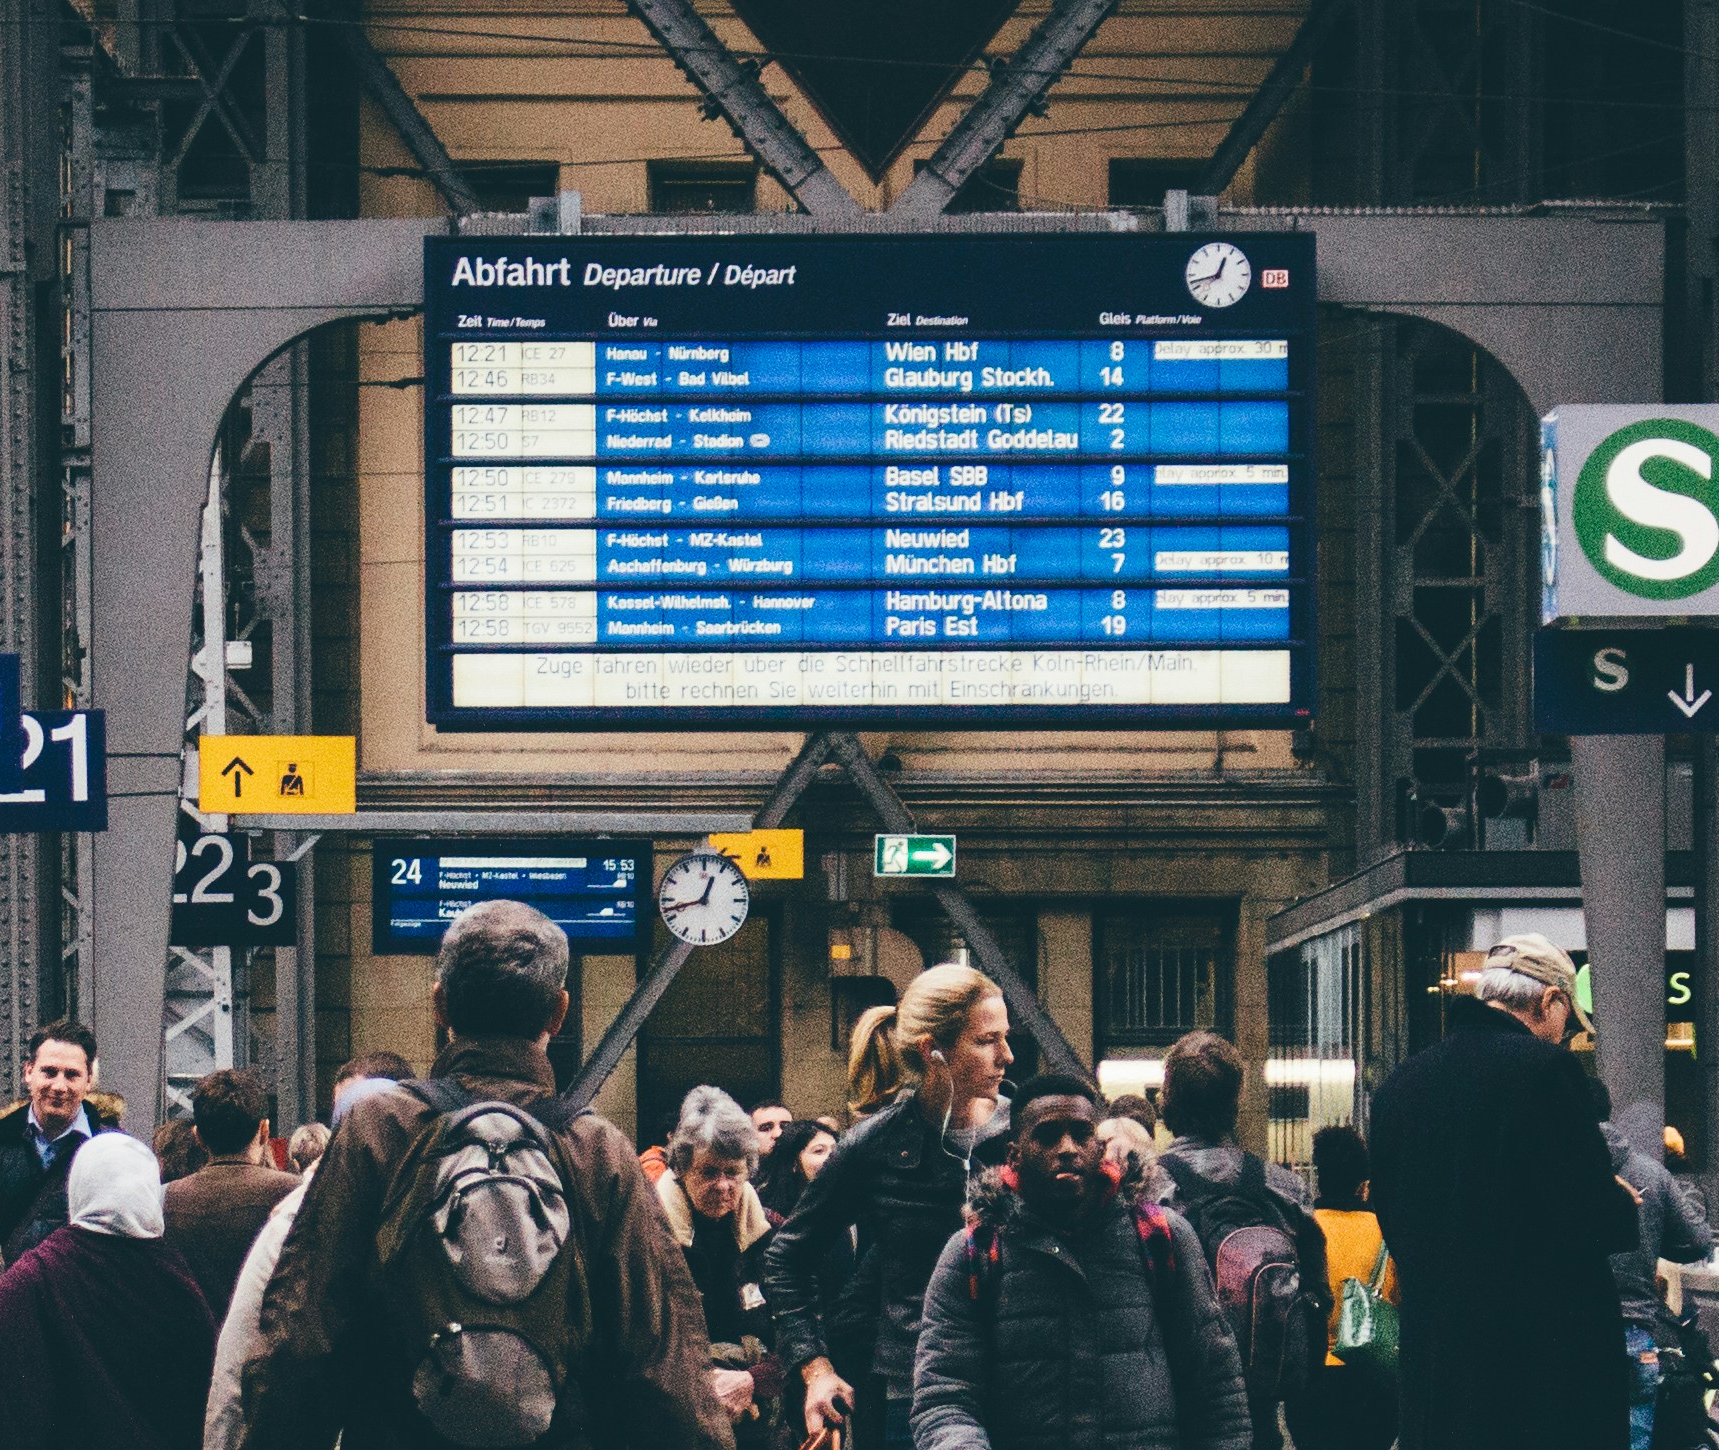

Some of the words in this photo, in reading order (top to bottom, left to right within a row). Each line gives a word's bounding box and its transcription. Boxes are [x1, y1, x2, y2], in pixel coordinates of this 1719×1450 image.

[451, 257, 571, 286] Abfahrt
[583, 264, 701, 290] Departure
[707, 262, 720, 285] /
[724, 264, 797, 289] Départ
[1265, 271, 1287, 286] DB
[458, 315, 482, 327] Zeit
[608, 312, 639, 327] Über
[643, 317, 658, 327] Via
[887, 312, 911, 326] Ziel
[915, 315, 968, 326] Destination
[1099, 312, 1131, 325] Gleis
[457, 345, 506, 362] 12:21
[605, 346, 648, 361] Hanau
[668, 346, 730, 364] Nürnberg
[885, 341, 937, 362] Wien
[944, 341, 979, 362] Hbf
[1109, 340, 1125, 362] 8
[457, 370, 508, 387] 12:46
[605, 371, 658, 387] F-West
[678, 371, 706, 387] Bad
[711, 371, 750, 387] Vilbel
[885, 367, 973, 392] Glauburg
[981, 366, 1055, 388] Stockh.
[1099, 366, 1124, 387] 14
[457, 407, 508, 424] 12:47
[606, 408, 668, 424] F-Höchst
[688, 408, 752, 423] Kelkheim
[885, 403, 987, 429] Königstein
[994, 403, 1033, 425] (Ts)
[1098, 403, 1125, 424] 22
[457, 433, 508, 450] 12:50
[606, 434, 673, 449] Niederrad
[693, 433, 744, 449] Stadion
[885, 429, 979, 450] Riedstadt
[987, 429, 1079, 450] Goddelau
[1109, 428, 1125, 450] 2
[457, 469, 508, 487] 12:50
[606, 471, 674, 486] Mannheim
[694, 470, 761, 485] Karlsruhe
[885, 466, 940, 487] Basel
[949, 466, 988, 487] SBB
[1110, 465, 1126, 486] 9
[457, 495, 507, 512] 12:51
[606, 496, 672, 514] Friedberg
[693, 496, 739, 511] Gießen
[885, 491, 982, 512] Stralsund
[989, 490, 1024, 512] Hbf
[1100, 490, 1126, 512] 16
[1605, 438, 1719, 581] S
[458, 532, 508, 549] 12:53
[606, 533, 669, 548] F-Höchst
[688, 533, 763, 548] MZ-Kastel
[885, 528, 970, 549] Neuwied
[1098, 528, 1126, 549] 23
[458, 557, 508, 575] 12:54
[607, 558, 707, 576] Aschaffenburg
[728, 558, 793, 575] Würzburg
[885, 554, 974, 574] München
[983, 553, 1017, 574] Hbf
[1111, 553, 1126, 574] 7
[459, 594, 509, 611] 12:58
[607, 595, 732, 610] Kassel-Wilhelmsh.
[753, 595, 816, 609] Hannover
[885, 590, 1048, 615] Hamburg-Altona
[1112, 589, 1126, 610] 8
[459, 620, 509, 637] 12:58
[607, 621, 675, 636] Mannheim
[696, 620, 782, 636] Saarbrücken
[885, 616, 937, 637] Paris
[944, 616, 979, 636] Est
[1101, 615, 1126, 636] 19
[595, 656, 657, 674] fahren
[668, 656, 733, 674] wieder
[799, 655, 825, 673] die
[836, 654, 1022, 672] Schnellfahrstrecke
[1593, 647, 1629, 691] S
[626, 682, 670, 699] bitte
[681, 682, 758, 699] rechnen
[769, 682, 796, 698] Sie
[809, 680, 898, 698] weiterhin
[908, 680, 940, 698] mit
[391, 859, 422, 884] 24
[247, 862, 284, 926] 3
[439, 880, 479, 889] Neuwied
